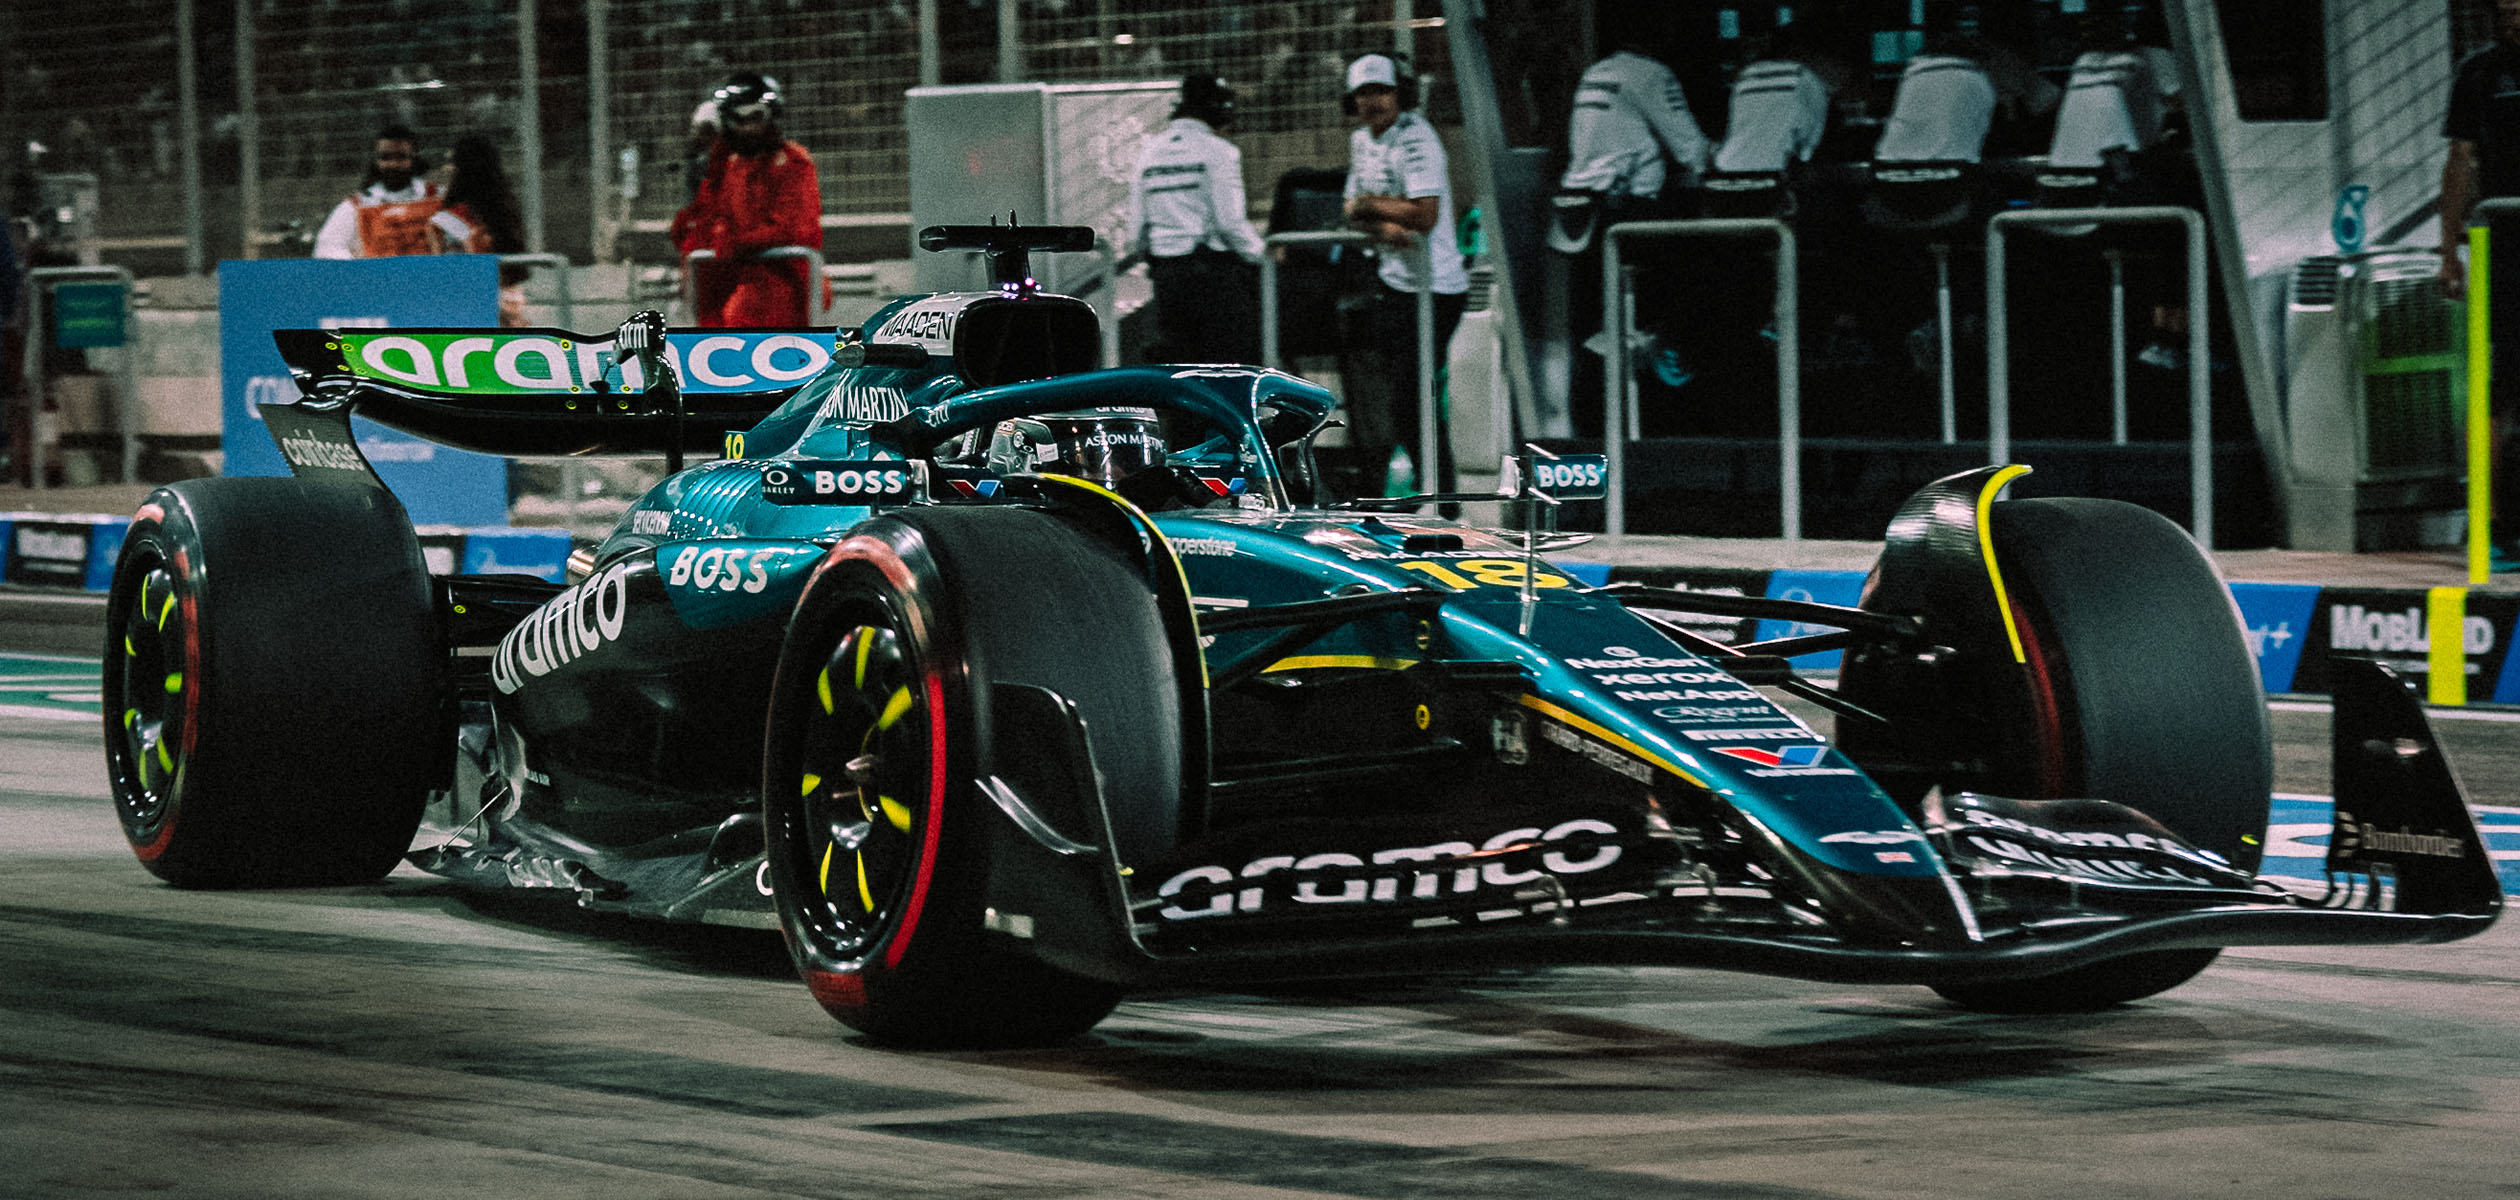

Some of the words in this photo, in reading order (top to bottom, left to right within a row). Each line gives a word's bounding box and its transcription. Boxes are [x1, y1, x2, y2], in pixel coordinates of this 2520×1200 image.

[619, 321, 648, 349] arm
[880, 311, 954, 340] MAADEN
[361, 334, 830, 388] aramco
[847, 386, 910, 422] MARTIN
[282, 429, 365, 471] coinbase
[815, 470, 902, 494] BOSS
[1536, 464, 1601, 488] BOSS
[669, 546, 773, 594] BOSS
[1397, 559, 1570, 589] 18
[491, 562, 626, 695] aramco
[2330, 604, 2495, 655] MOBLD
[1593, 671, 1738, 686] xerox
[1615, 689, 1760, 701] NetApp
[1159, 819, 1622, 920] aramco
